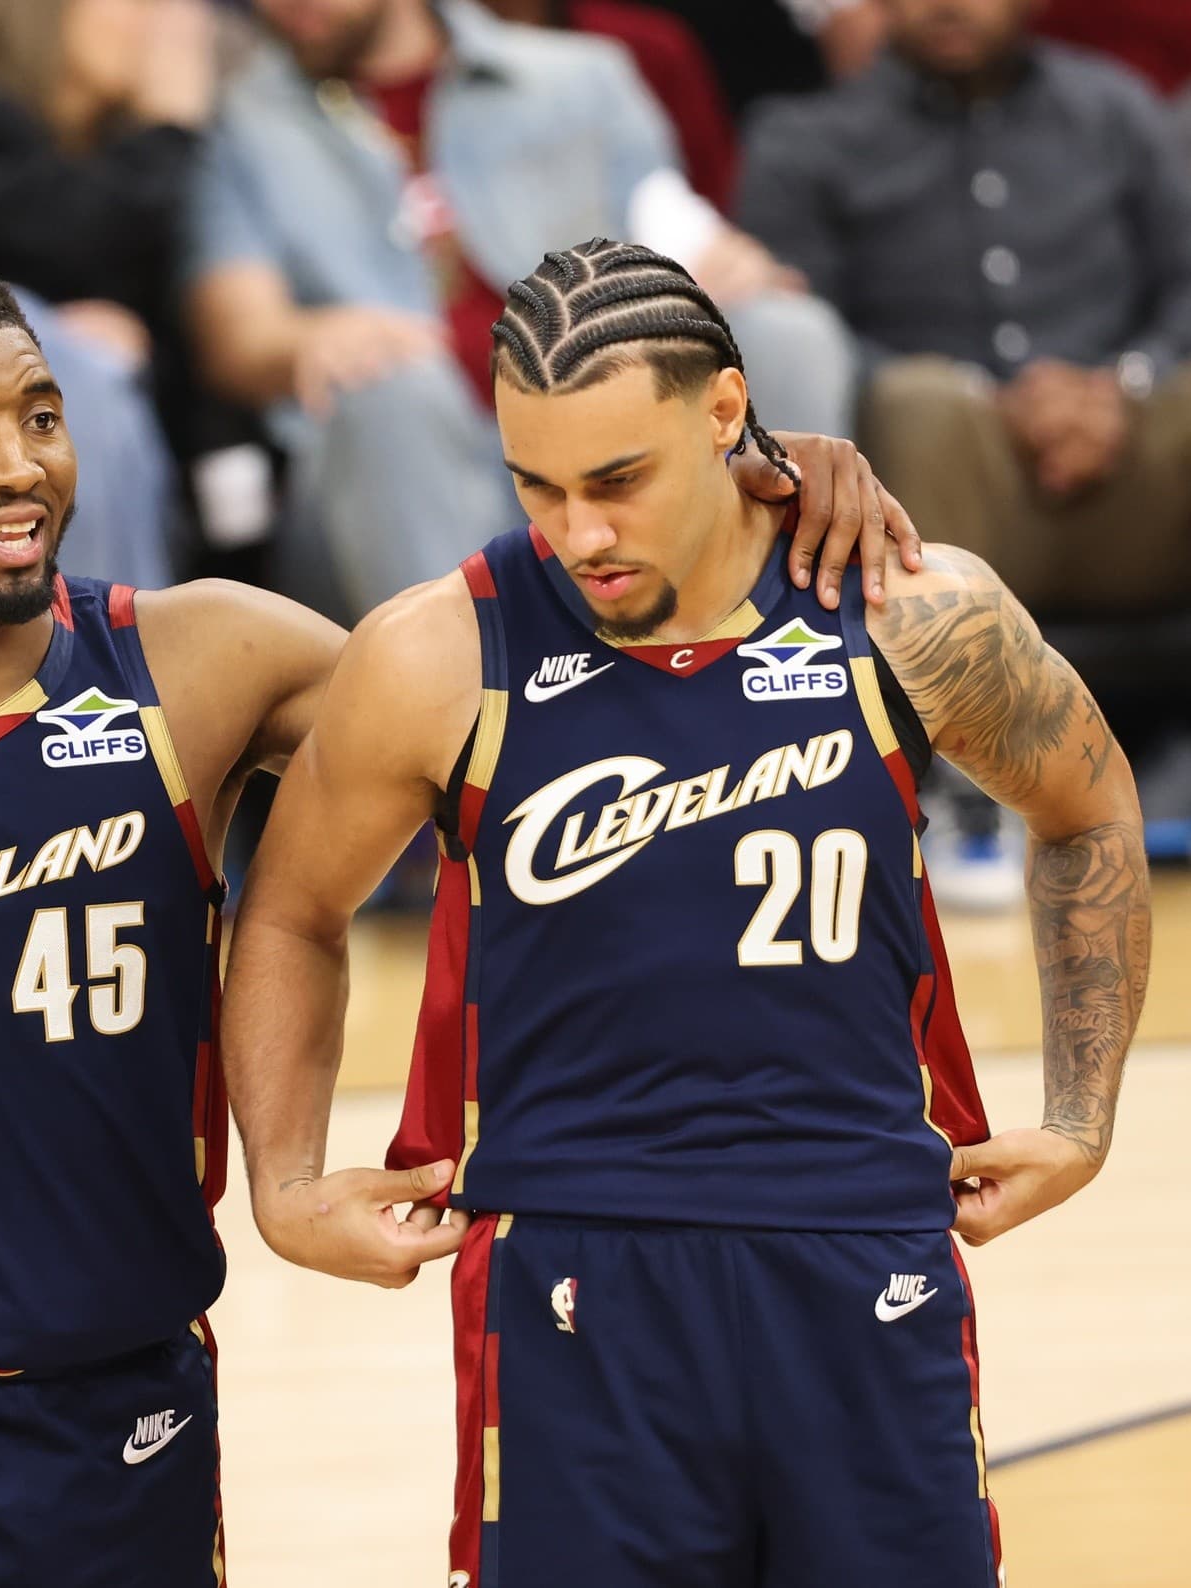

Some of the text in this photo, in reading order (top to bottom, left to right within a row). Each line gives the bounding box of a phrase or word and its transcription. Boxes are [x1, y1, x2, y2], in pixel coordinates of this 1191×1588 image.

[538, 653, 591, 683] NIKE
[669, 649, 694, 669] C
[747, 671, 844, 694] CLIFFS
[46, 736, 143, 761] CLIFFS
[502, 728, 853, 906] CLEVELAND
[734, 827, 868, 967] 20
[11, 900, 147, 1043] 45
[887, 1273, 927, 1302] NIKE
[134, 1409, 175, 1445] NIKE
